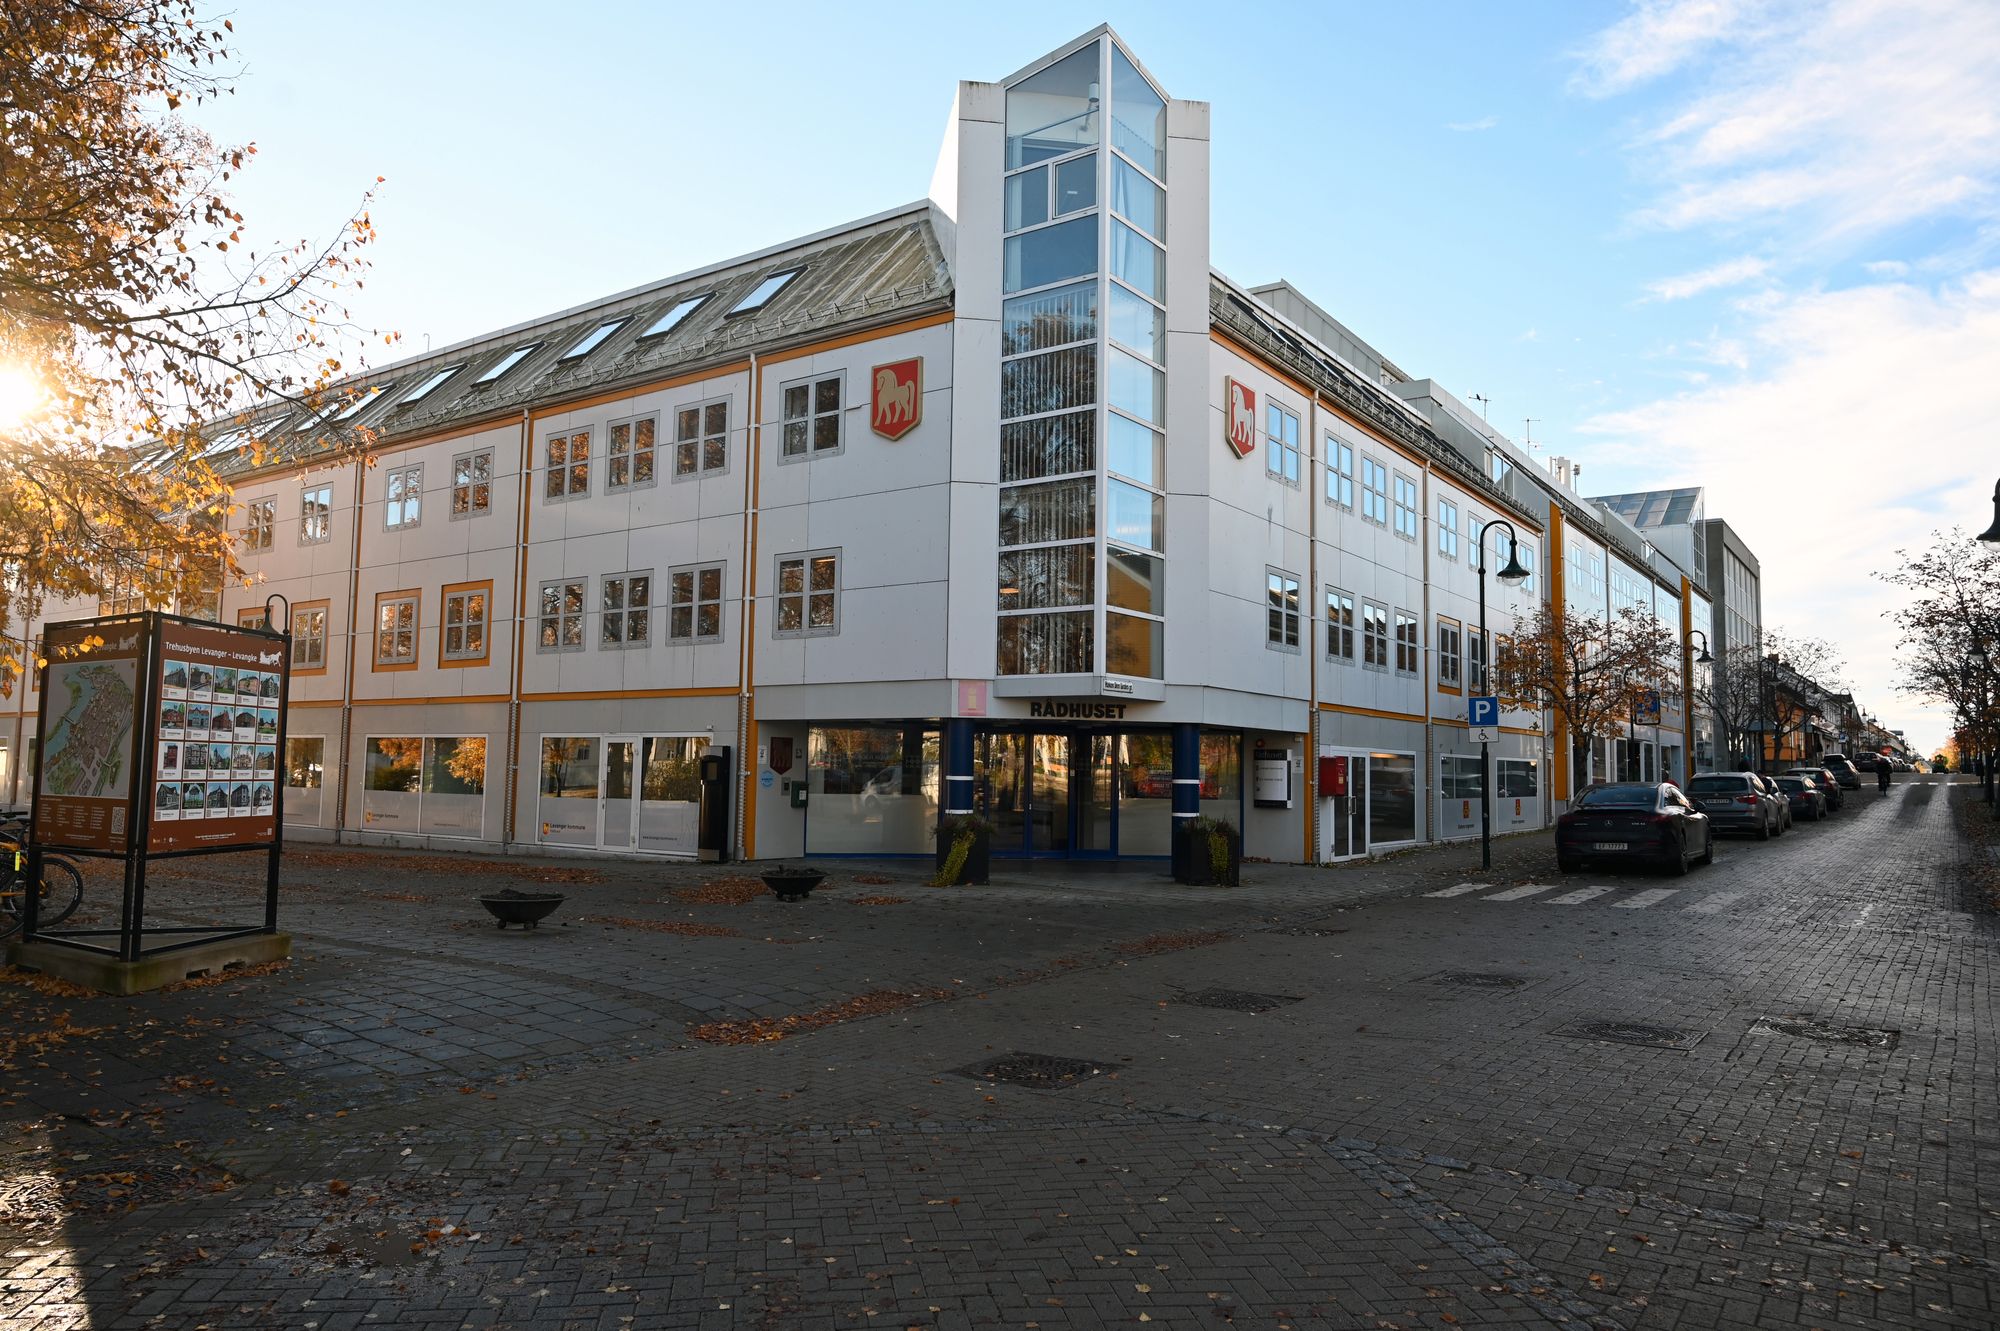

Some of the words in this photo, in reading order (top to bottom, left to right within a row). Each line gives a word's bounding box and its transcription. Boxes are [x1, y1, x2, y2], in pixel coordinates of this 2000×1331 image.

[165, 641, 201, 655] Trehusbyen
[201, 647, 228, 659] Levanger
[232, 651, 257, 662] Levangke
[1030, 697, 1127, 719] RÅDHUSET
[1475, 700, 1491, 722] P
